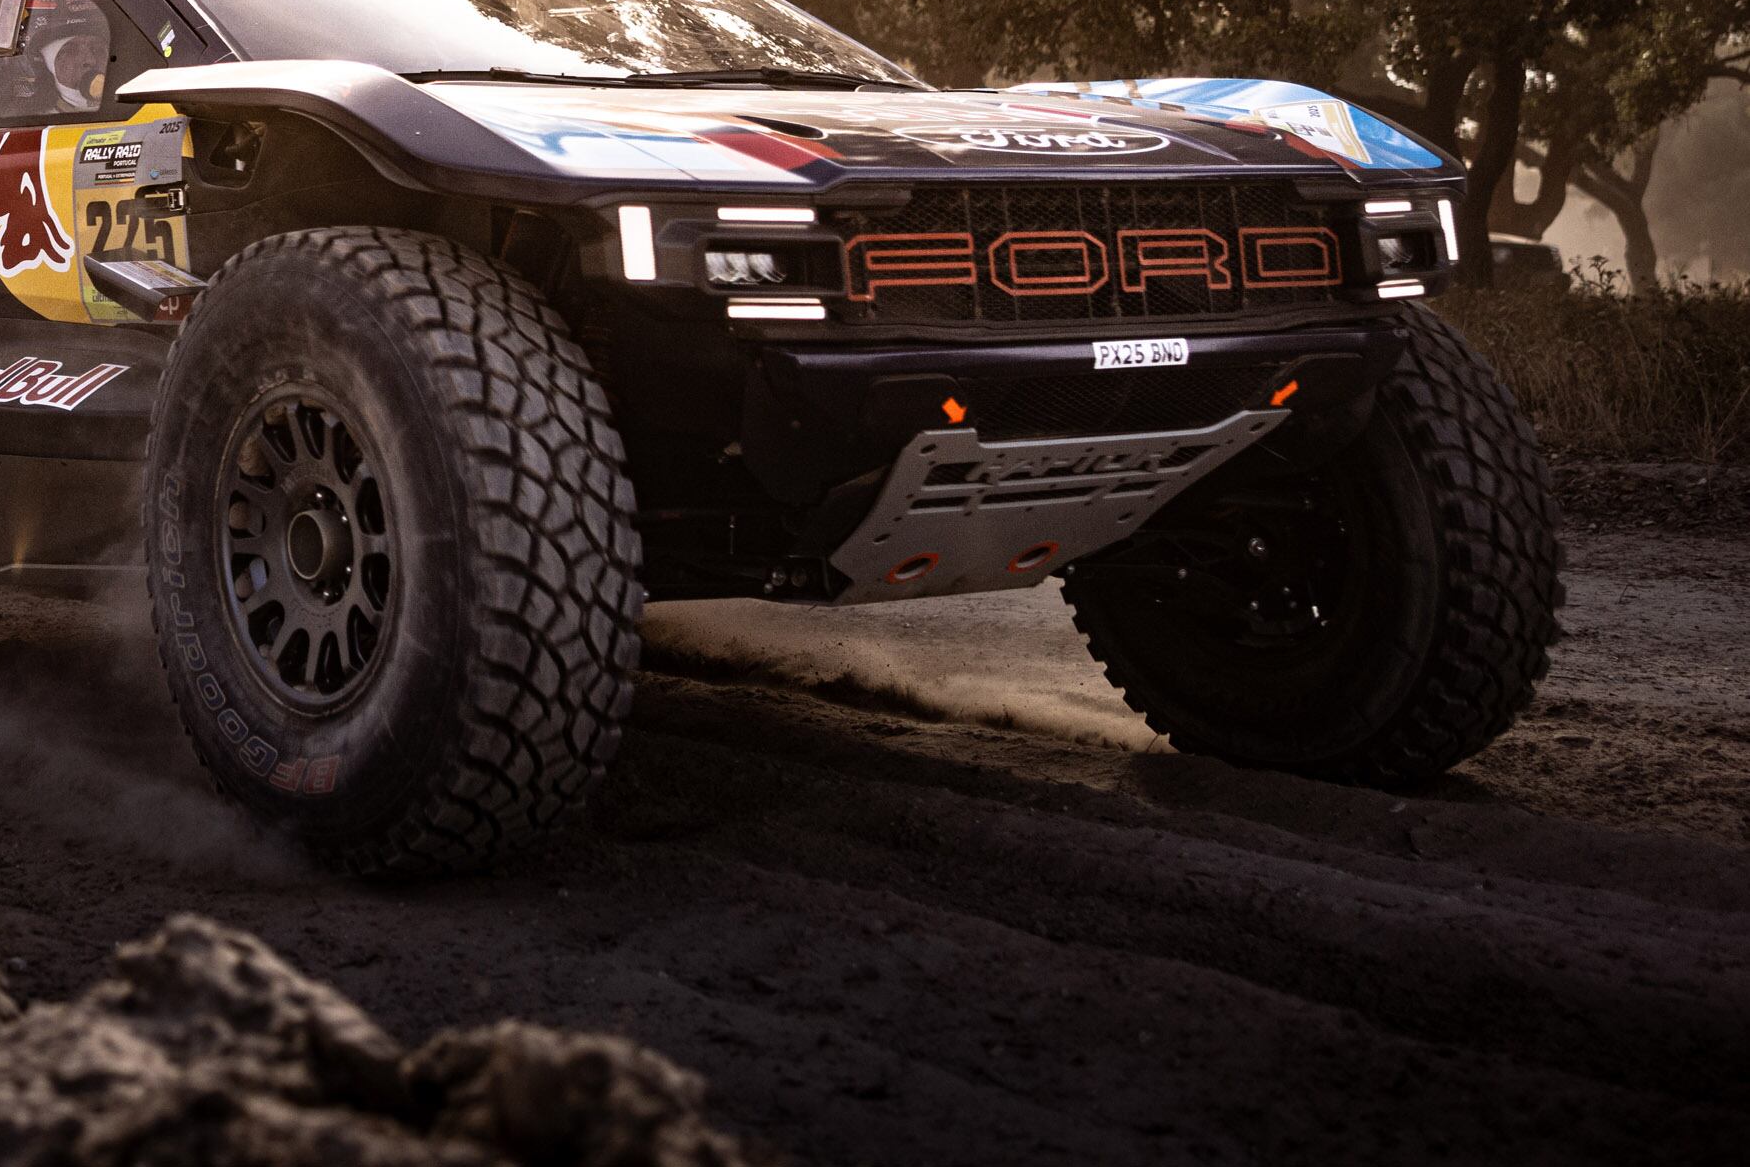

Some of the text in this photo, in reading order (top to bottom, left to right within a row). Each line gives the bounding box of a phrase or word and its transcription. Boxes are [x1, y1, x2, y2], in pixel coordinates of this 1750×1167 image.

[958, 128, 1127, 149] Ford
[84, 144, 142, 161] RALLY RAID
[113, 159, 138, 167] PORTUGAL
[86, 200, 176, 267] 225
[846, 227, 1344, 302] FORD
[1099, 344, 1145, 367] PX25
[159, 474, 340, 795] BFGoodrich
